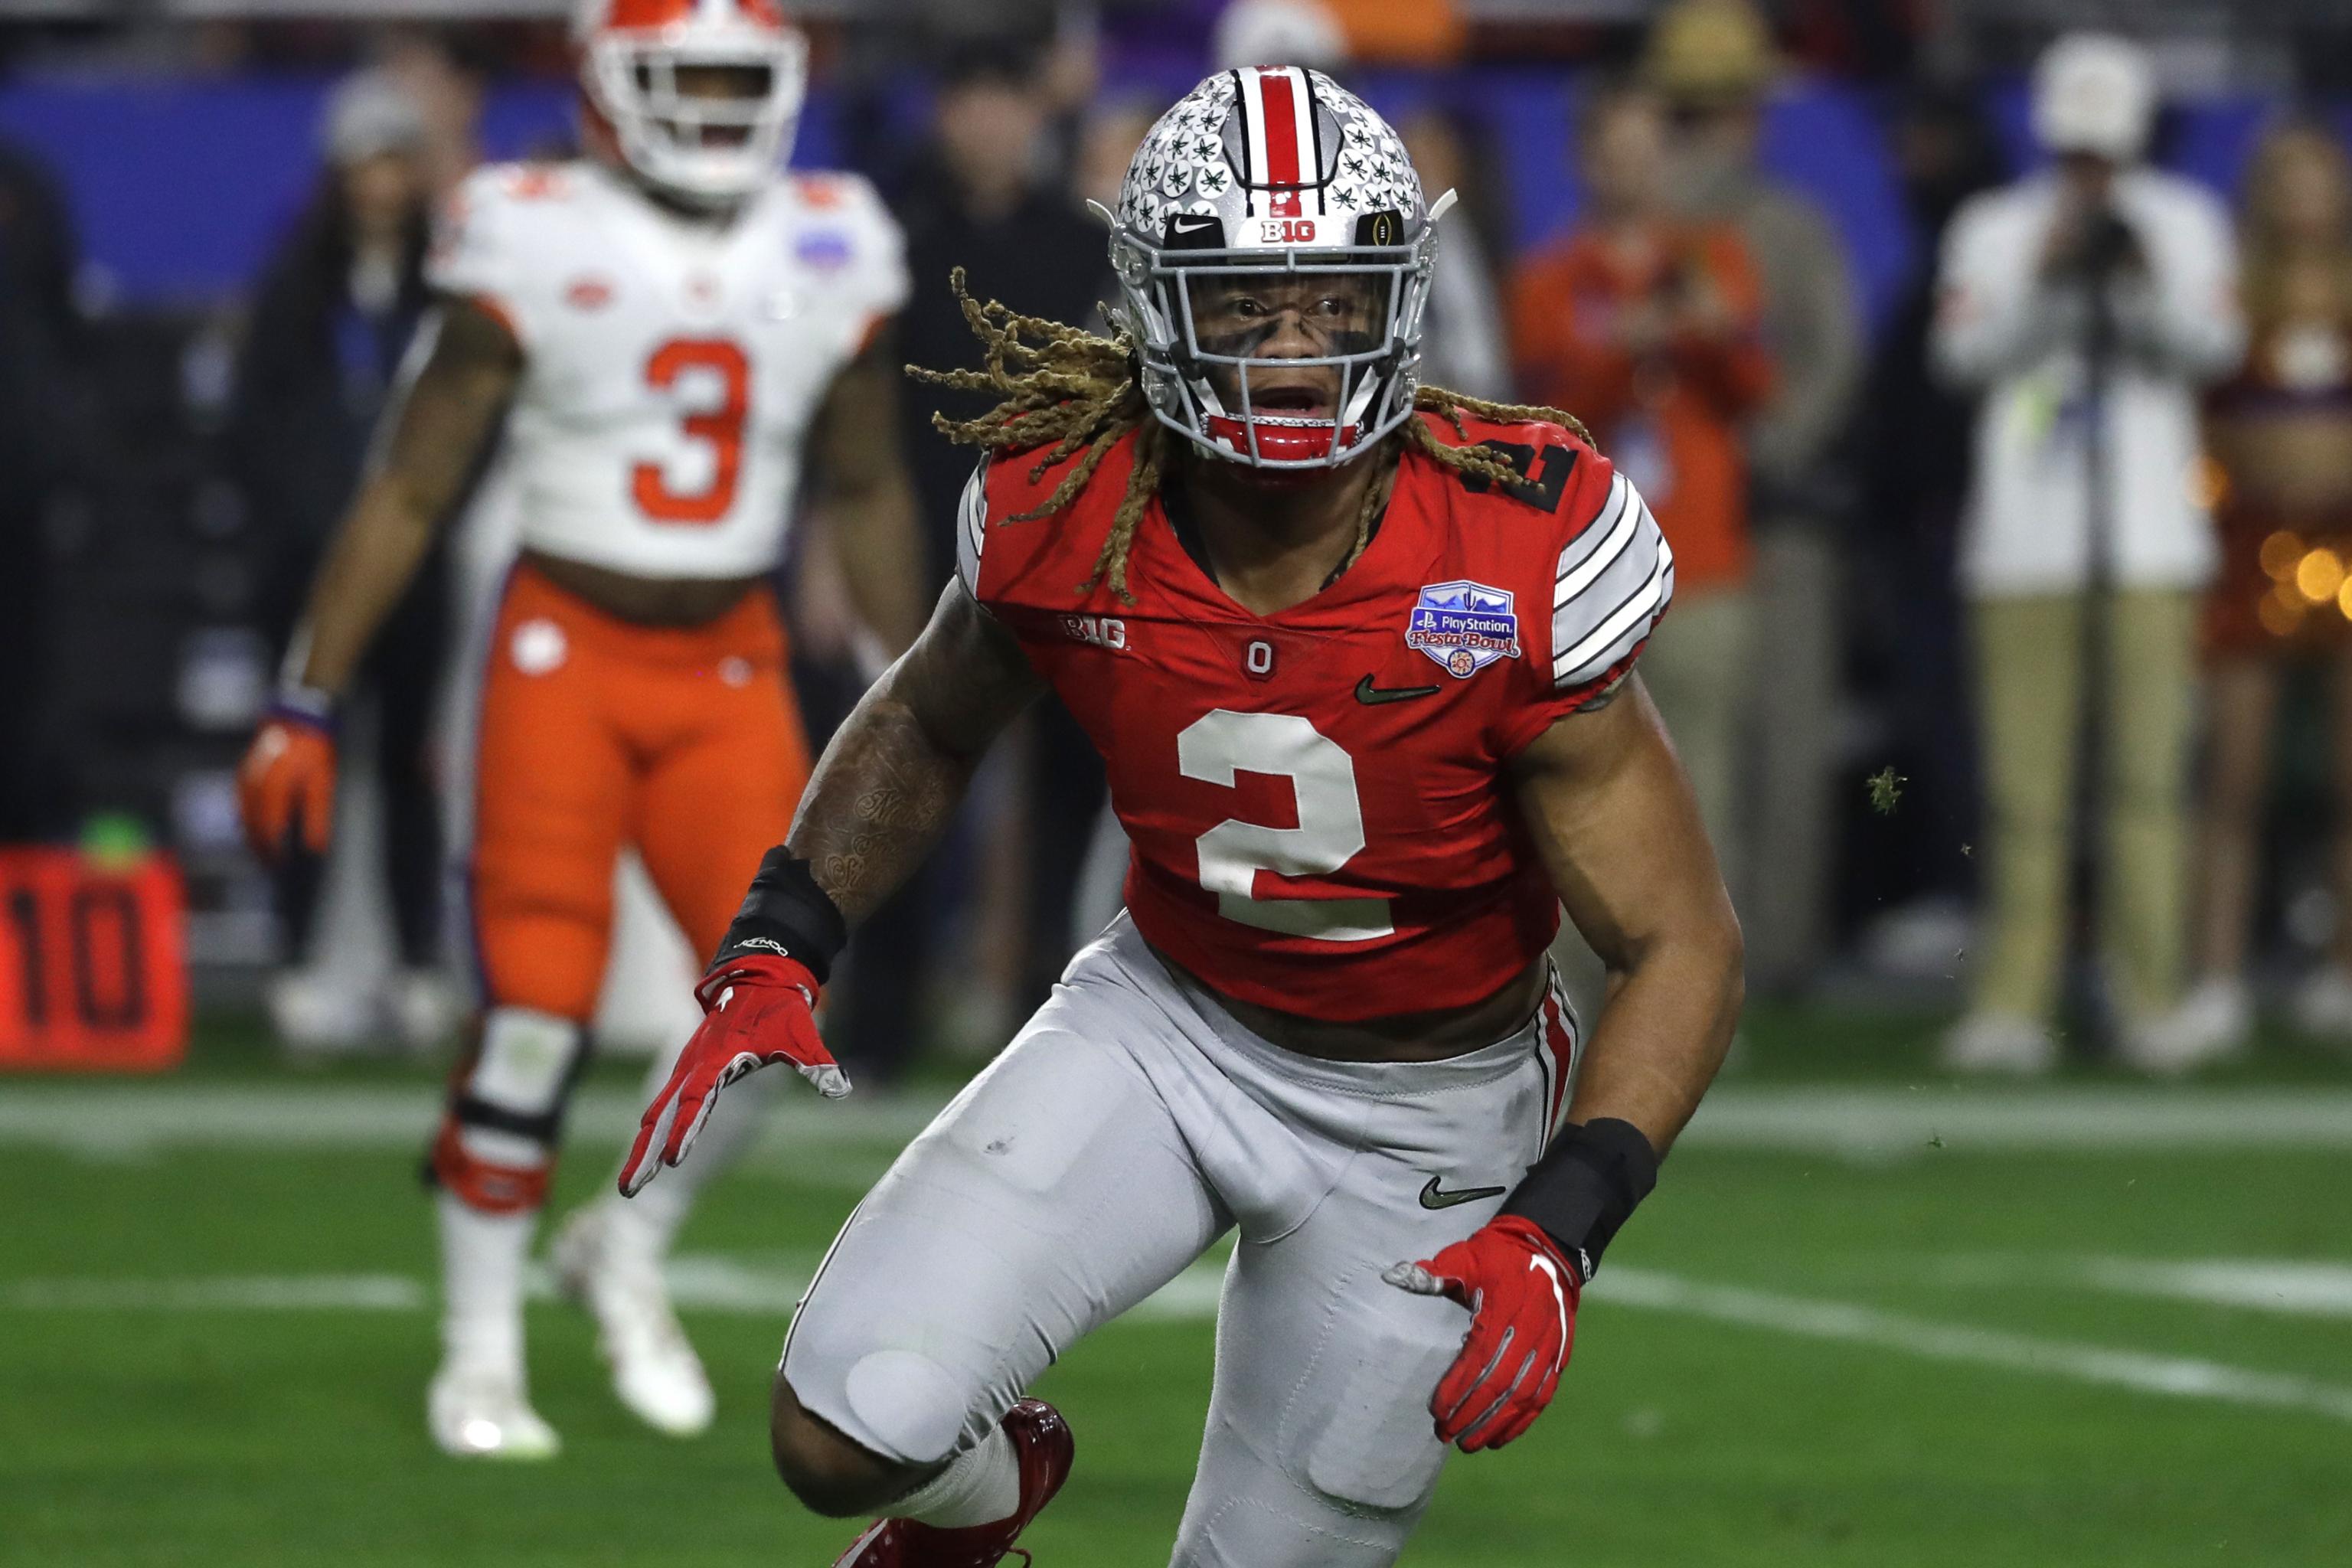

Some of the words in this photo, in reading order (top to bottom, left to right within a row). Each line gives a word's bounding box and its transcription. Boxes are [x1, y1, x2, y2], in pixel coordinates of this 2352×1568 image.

[632, 338, 750, 524] 3
[1410, 630, 1462, 645] Fiesta
[1463, 632, 1514, 652] Bowl
[1442, 616, 1510, 633] PlayStation
[1178, 708, 1394, 942] 2
[9, 886, 147, 1031] 10
